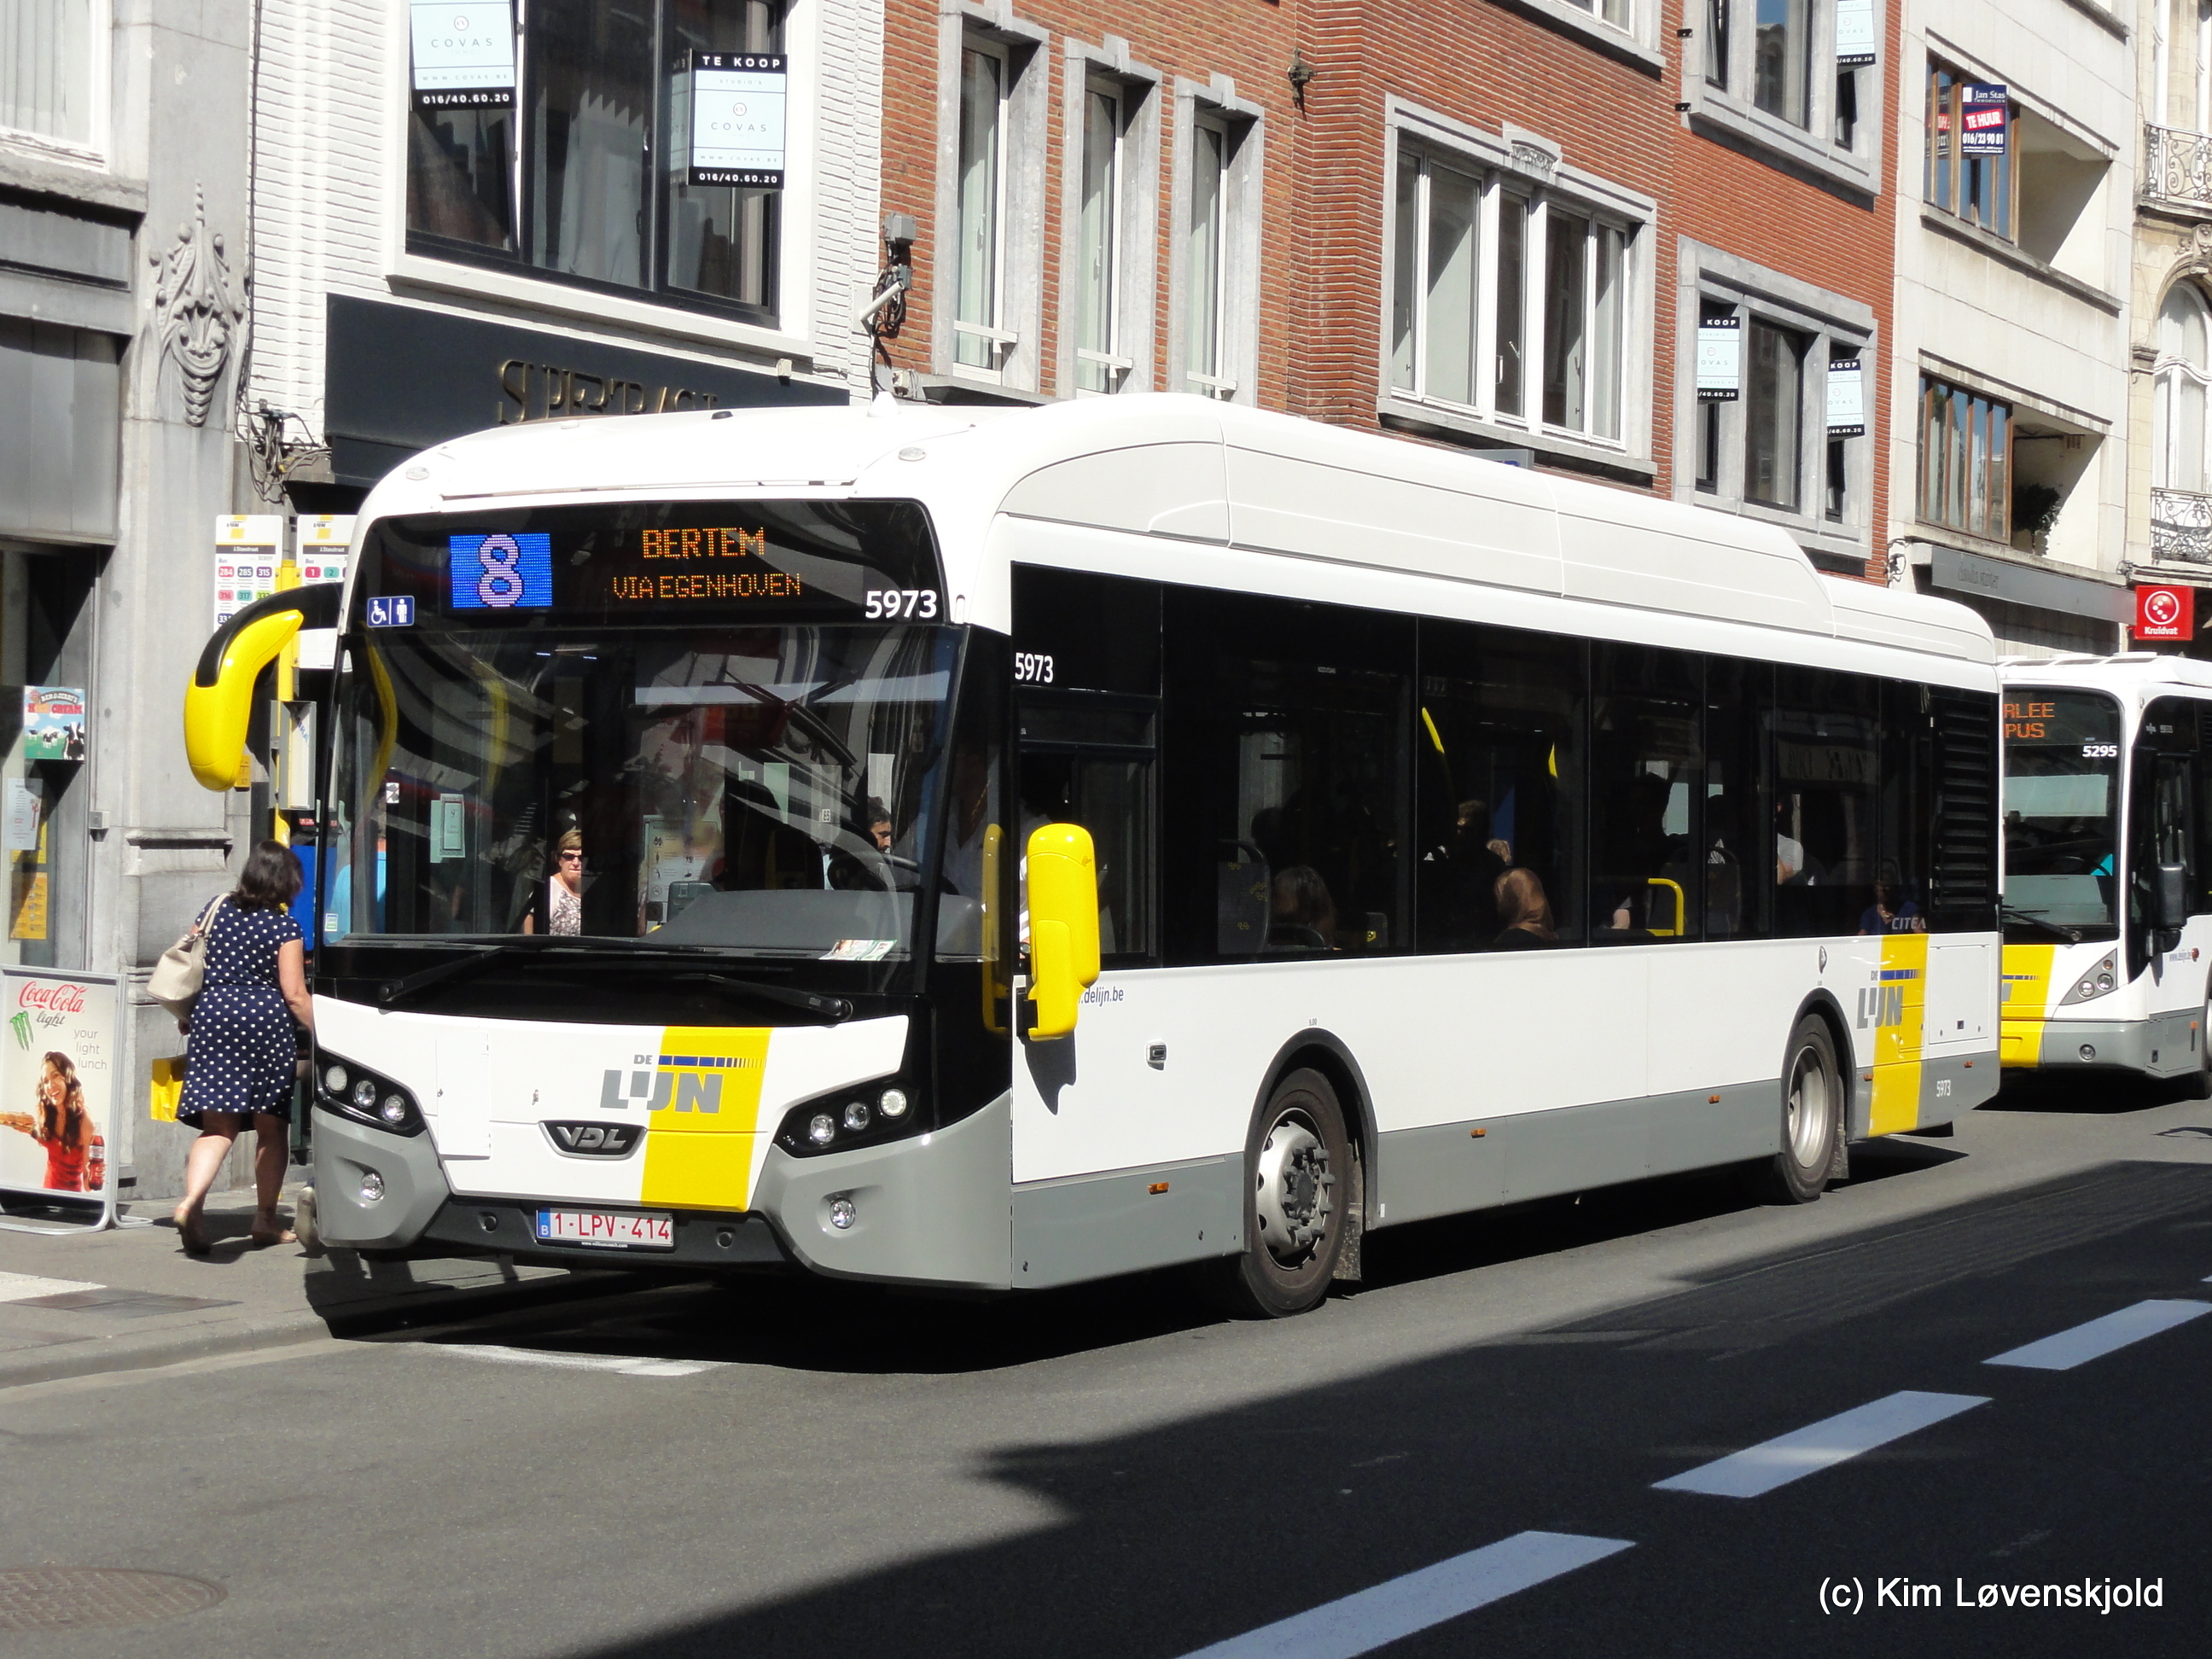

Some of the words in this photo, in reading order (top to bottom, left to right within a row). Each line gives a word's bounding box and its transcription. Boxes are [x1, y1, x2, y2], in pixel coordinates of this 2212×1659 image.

[431, 38, 492, 49] COVAS
[702, 55, 722, 66] TE
[734, 57, 780, 68] KOOP
[423, 94, 509, 104] 016/40.60.20
[1976, 90, 1988, 99] Jan
[1989, 90, 2005, 99] Stas
[1966, 115, 1977, 129] TE
[1976, 111, 2002, 127] HUUR
[711, 122, 767, 132] COVAS
[1963, 132, 1986, 144] 016/23
[1987, 133, 1995, 144] 90
[1996, 133, 2004, 144] 81
[699, 172, 777, 183] 016/40.60.20
[643, 527, 766, 560] BERTEM
[219, 568, 233, 576] 284
[238, 568, 252, 576] 285
[477, 534, 525, 608] 8
[613, 575, 654, 601] VIA
[659, 573, 802, 600] EGENHOVEN
[864, 590, 937, 621] 5973
[2144, 626, 2179, 635] Kruidvat
[1015, 652, 1054, 683] 5973
[2082, 745, 2118, 758] 5295
[1891, 917, 1927, 930] CITEA
[1856, 985, 1904, 1029] LIJN
[36, 1010, 67, 1027] light
[73, 1028, 98, 1039] your
[76, 1041, 100, 1055] light
[78, 1057, 108, 1070] lunch
[633, 1054, 654, 1065] DE
[600, 1069, 724, 1114] LIJN
[1936, 1079, 1952, 1097] 5973
[556, 1126, 626, 1149] VDL
[541, 1225, 549, 1235] B
[555, 1213, 671, 1240] 1-LPV-414
